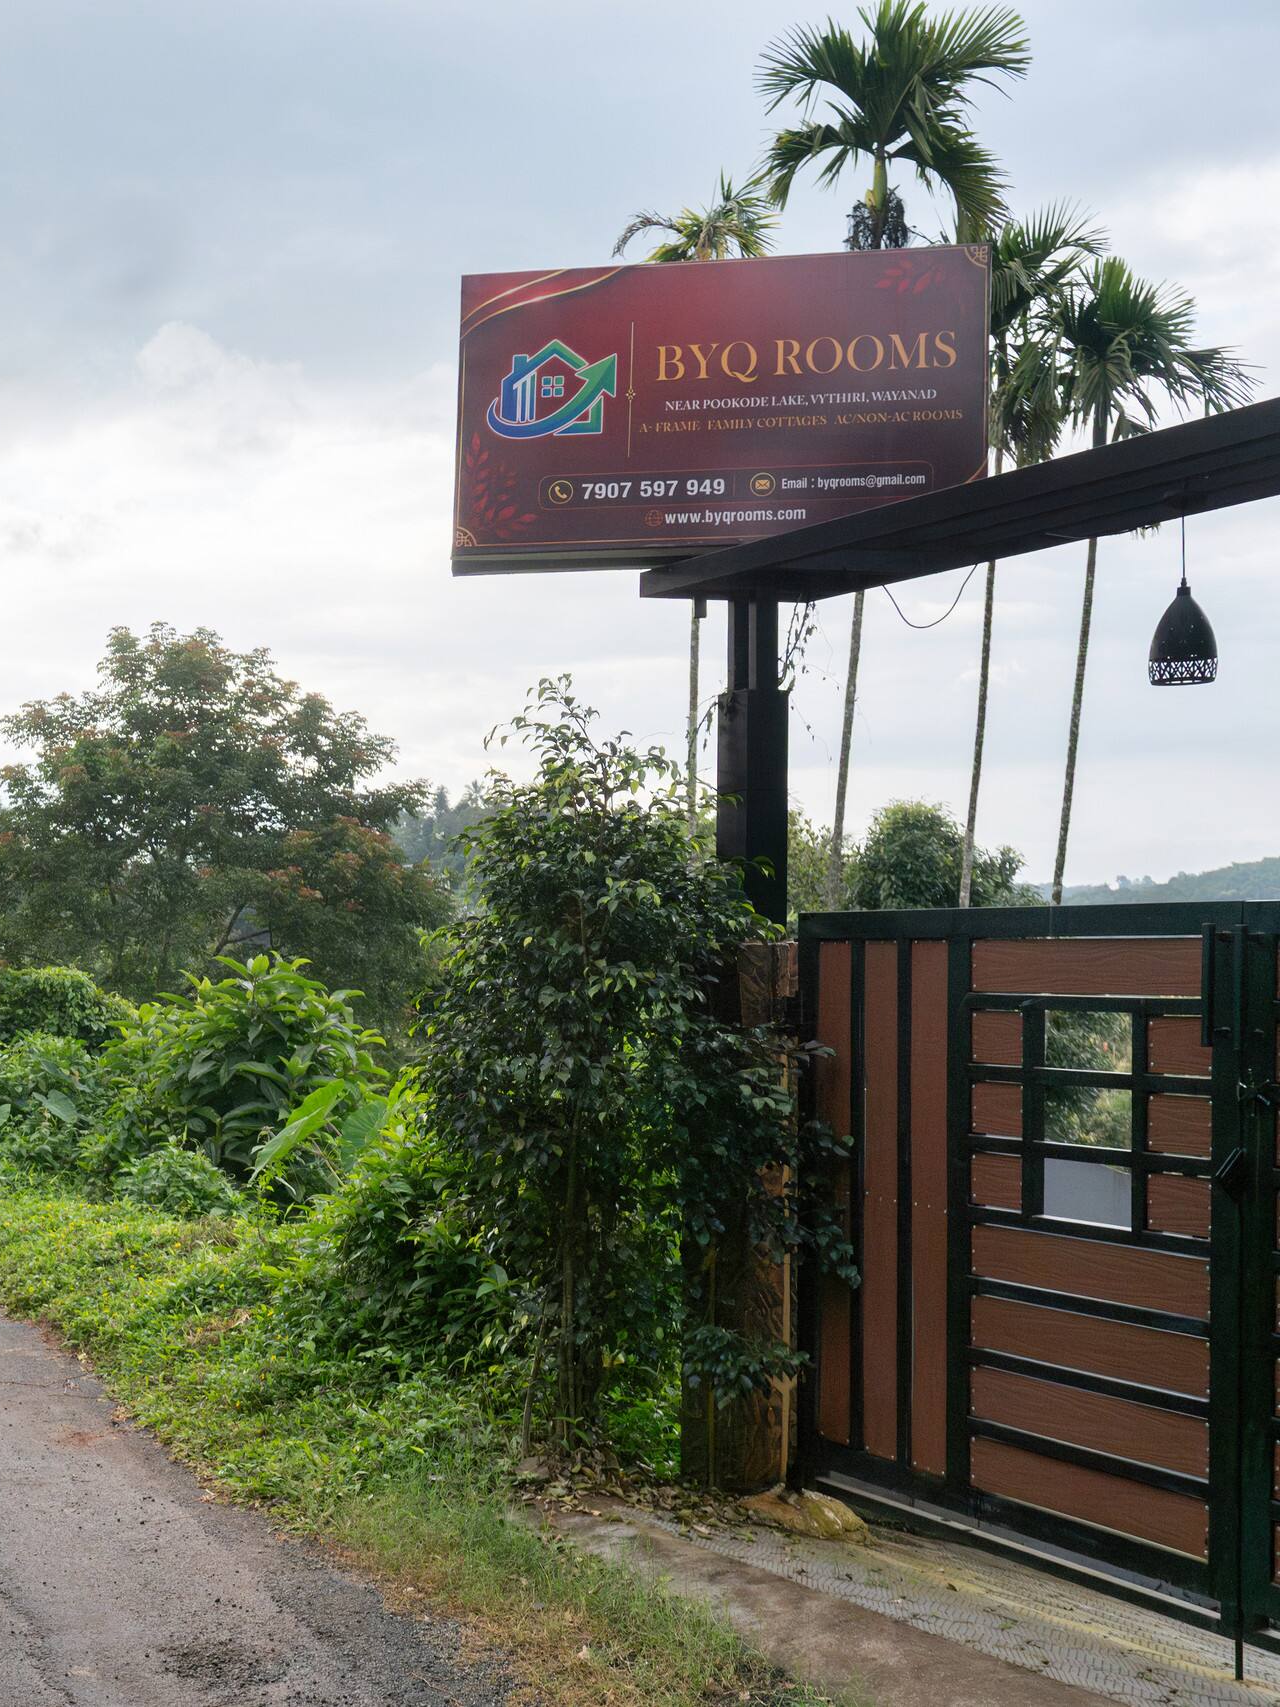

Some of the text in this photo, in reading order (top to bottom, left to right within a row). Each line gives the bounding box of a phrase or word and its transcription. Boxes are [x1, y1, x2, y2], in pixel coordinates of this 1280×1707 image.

[656, 330, 957, 383] BYQ ROOMS
[665, 388, 937, 411] NEAR POOKODE LAKE, VYTHIRI, WAYANAD
[707, 417, 754, 430] FAMILY
[756, 415, 827, 428] COTTAGES
[834, 412, 911, 425] AC/NON-AC
[912, 409, 963, 421] ROOMS
[582, 478, 726, 499] 7907 597 949
[781, 477, 807, 489] Email
[817, 473, 926, 490] byqrooms@gmail.com
[664, 508, 806, 526] www.byqrooms.com
